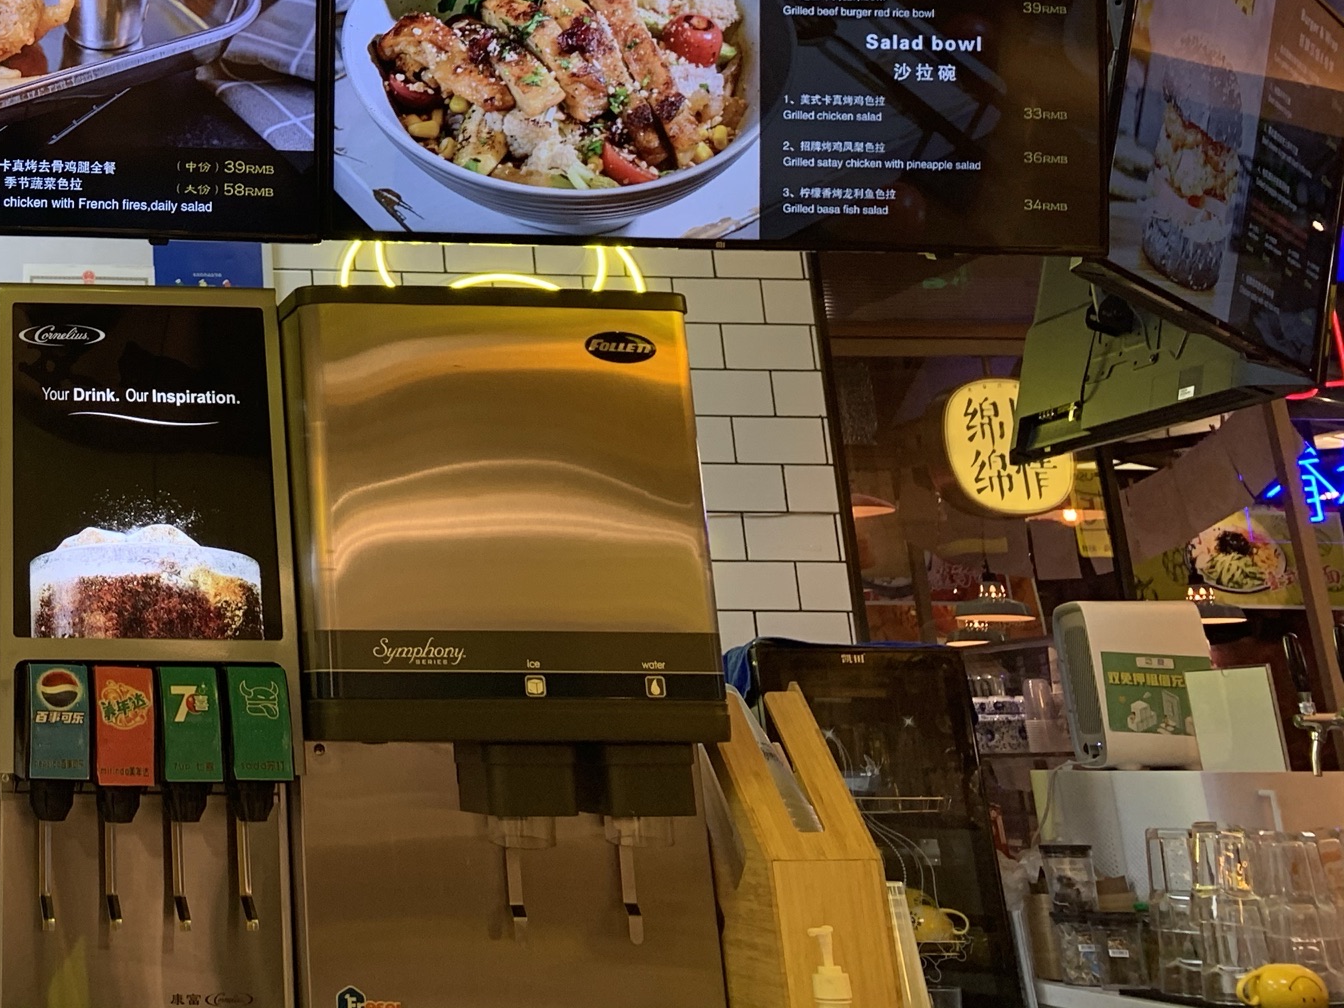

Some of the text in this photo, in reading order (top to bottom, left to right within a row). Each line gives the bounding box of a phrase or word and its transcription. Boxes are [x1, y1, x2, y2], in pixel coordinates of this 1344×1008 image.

[783, 5, 935, 19] Grilled beef burger red rice bowl
[1022, 2, 1067, 15] 39RMB
[866, 34, 982, 52] Salad bowl
[893, 63, 957, 82] 沙拉碗
[783, 110, 882, 121] Grilled chicken salad
[1023, 107, 1068, 120] 33RMB
[783, 156, 981, 171] Grilled satay chicken with pineapple salad
[1023, 152, 1068, 164] 36RMB
[3, 196, 48, 208] chicken
[51, 197, 75, 209] with
[78, 198, 119, 210] French
[180, 201, 213, 213] salad
[783, 203, 889, 215] Grilled basa fish salad
[1023, 199, 1068, 212] 34RMB
[34, 325, 89, 343] Cornelius
[42, 386, 241, 406] Your Drink. Our Inspiration.
[642, 660, 666, 670] water
[36, 711, 85, 724] 百事可乐
